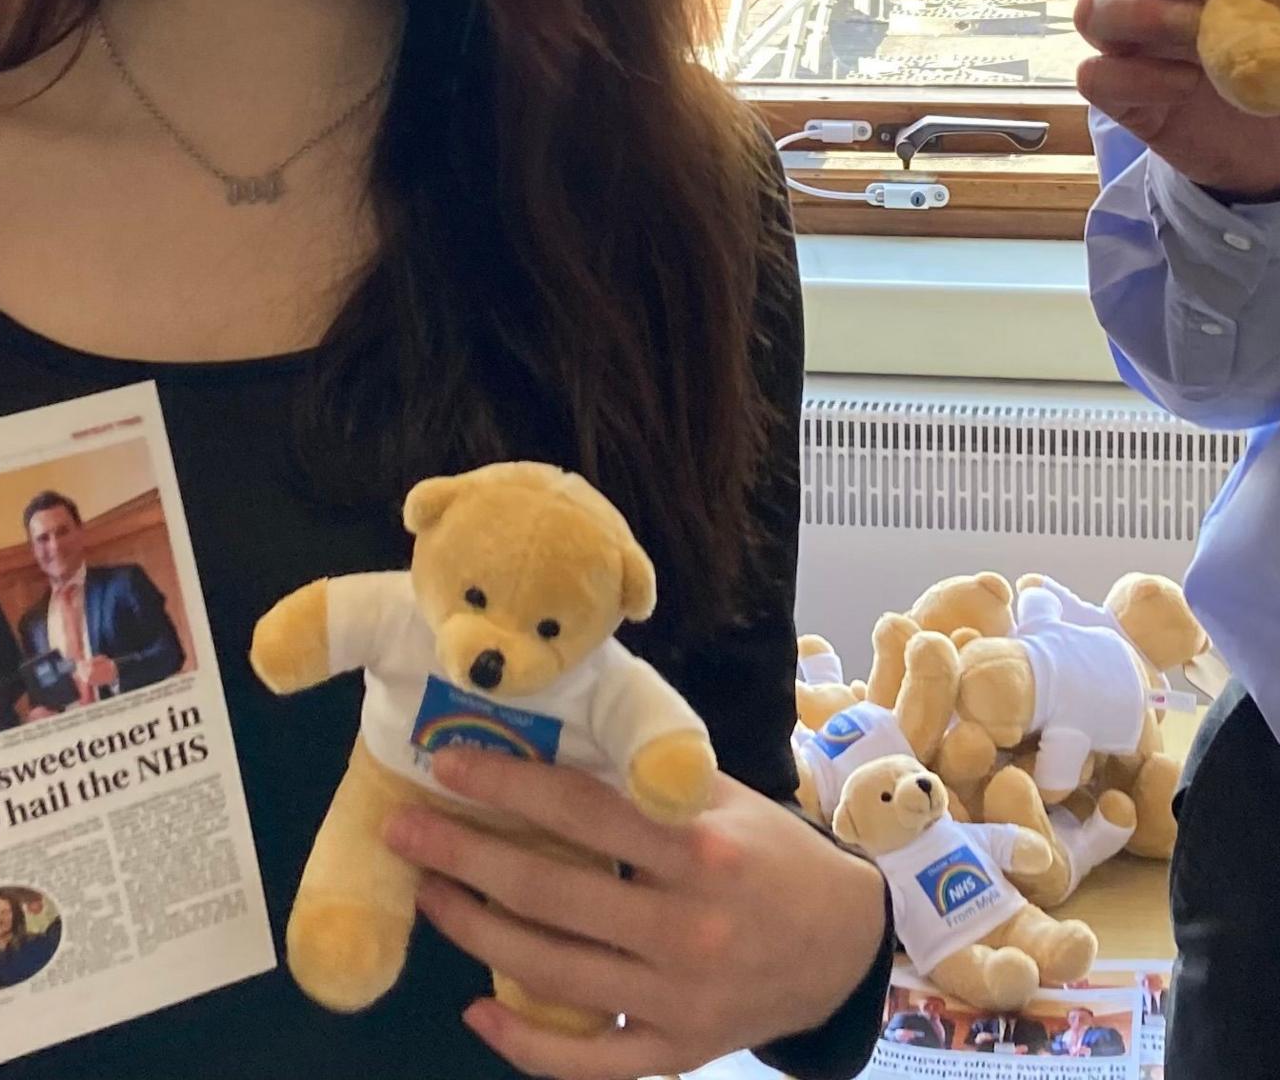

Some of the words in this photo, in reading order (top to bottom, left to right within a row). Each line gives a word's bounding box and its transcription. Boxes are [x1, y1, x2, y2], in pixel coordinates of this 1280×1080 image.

[167, 704, 201, 733] in
[5, 782, 71, 828] hail
[78, 763, 129, 801] the
[138, 734, 210, 784] NHS
[948, 876, 977, 904] NHS
[946, 901, 976, 928] From
[975, 889, 1002, 916] Myla
